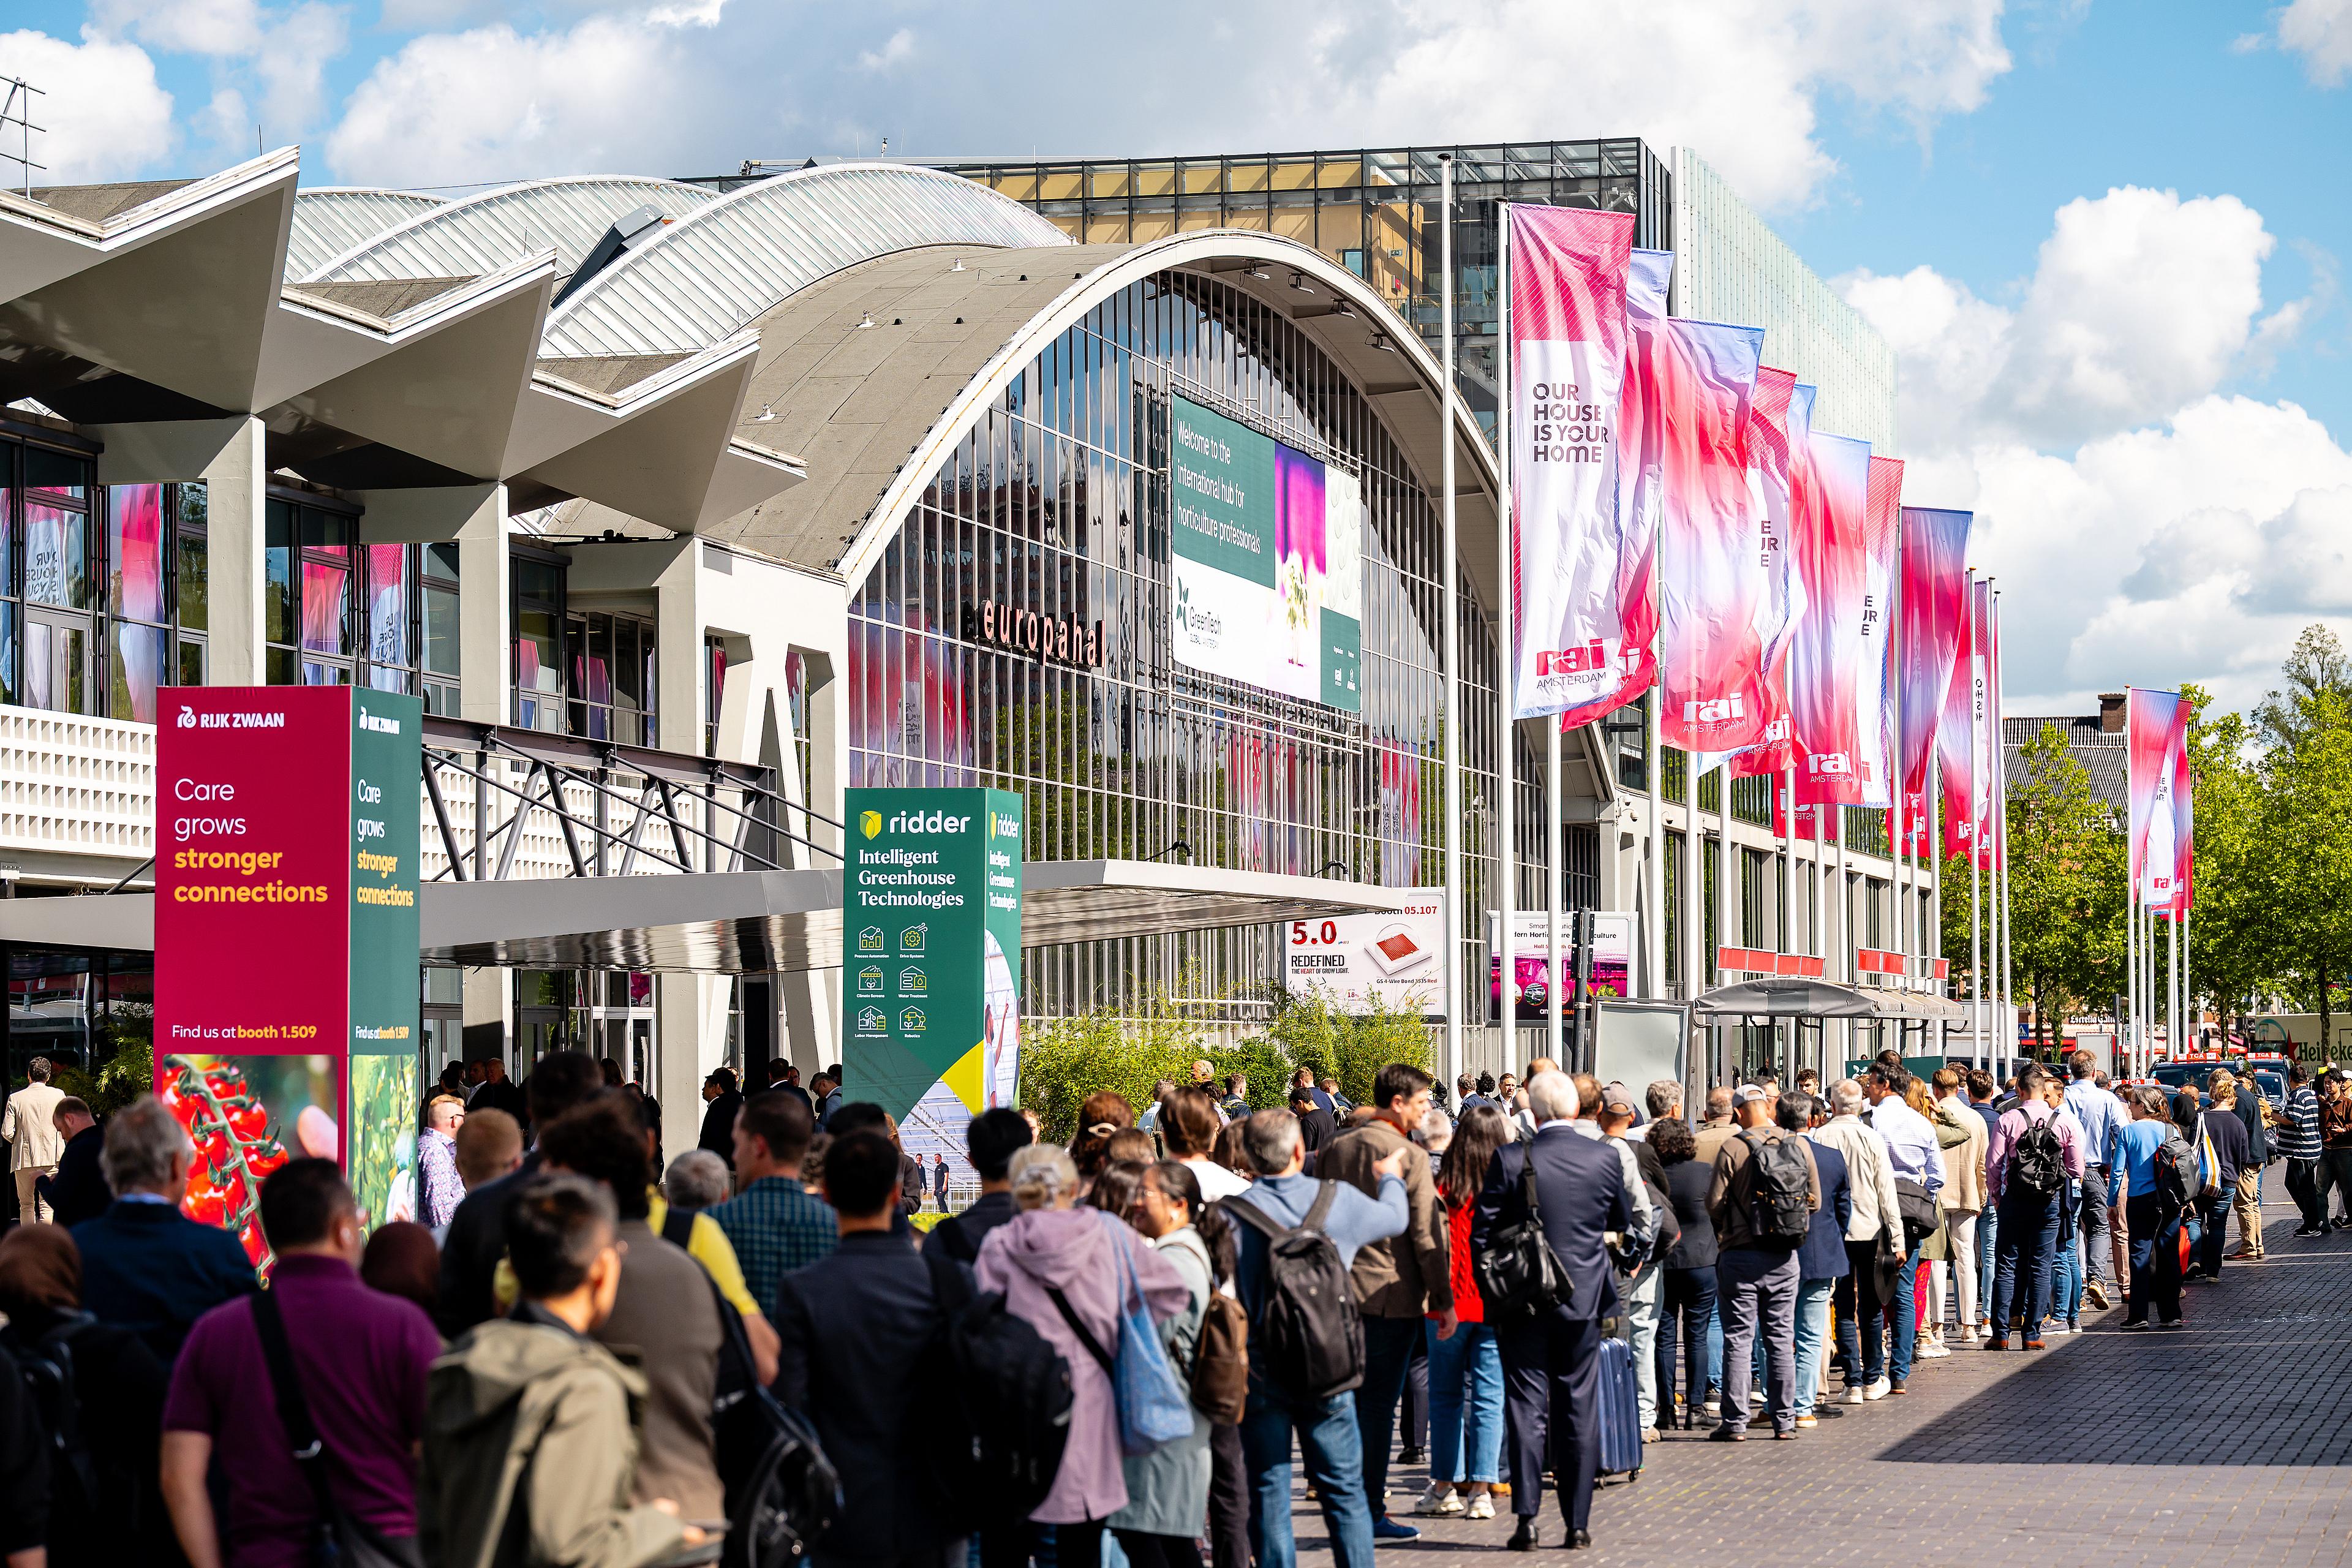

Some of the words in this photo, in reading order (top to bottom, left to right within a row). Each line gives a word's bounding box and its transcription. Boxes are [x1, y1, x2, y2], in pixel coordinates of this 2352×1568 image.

[1533, 383, 1579, 401] OUR
[1534, 403, 1601, 421] HOUSE
[1177, 418, 1210, 456] Welcome
[1210, 435, 1218, 459] to
[1219, 438, 1231, 465] the
[1534, 424, 1552, 441] IS
[1556, 424, 1608, 443] YOUR
[1177, 458, 1220, 500] international
[1221, 477, 1234, 505] hub
[1235, 483, 1245, 509] for
[1177, 498, 1218, 538] horticulture
[1219, 519, 1261, 554] professionals
[1190, 606, 1221, 635] GreenTech
[984, 600, 1105, 668] europahal
[1537, 638, 1605, 676] rai
[1536, 672, 1606, 689] AMSTERDAM
[1683, 692, 1744, 722] rai
[200, 713, 230, 728] RIJK
[232, 712, 285, 728] ZWAAN
[1683, 720, 1745, 733] AMSTERDAM
[175, 778, 235, 801] Care
[358, 778, 382, 804] Care
[175, 818, 246, 842] grows
[357, 818, 385, 842] grows
[889, 810, 971, 834] ridder
[997, 813, 1019, 838] ridder
[174, 848, 283, 875] stronger
[357, 849, 398, 878] stronger
[859, 848, 939, 867] Intelligent
[989, 850, 1011, 869] Intelligent
[858, 870, 956, 886] Greenhouse
[989, 871, 1015, 888] Greenhouse
[174, 880, 328, 902] connections
[356, 884, 414, 907] connections
[858, 890, 964, 910] Technologies
[989, 891, 1017, 911] Technologies
[1291, 921, 1337, 944] 5.0
[1291, 955, 1344, 967] REDEFINED
[172, 1025, 200, 1038] Find
[203, 1027, 219, 1038] us
[222, 1027, 236, 1038] at
[237, 1025, 278, 1039] booth
[281, 1025, 317, 1039] 1.509
[355, 1025, 368, 1039] Find
[380, 1026, 395, 1039] booth
[395, 1026, 410, 1039] 1.509
[2298, 1041, 2352, 1062] Heieke
